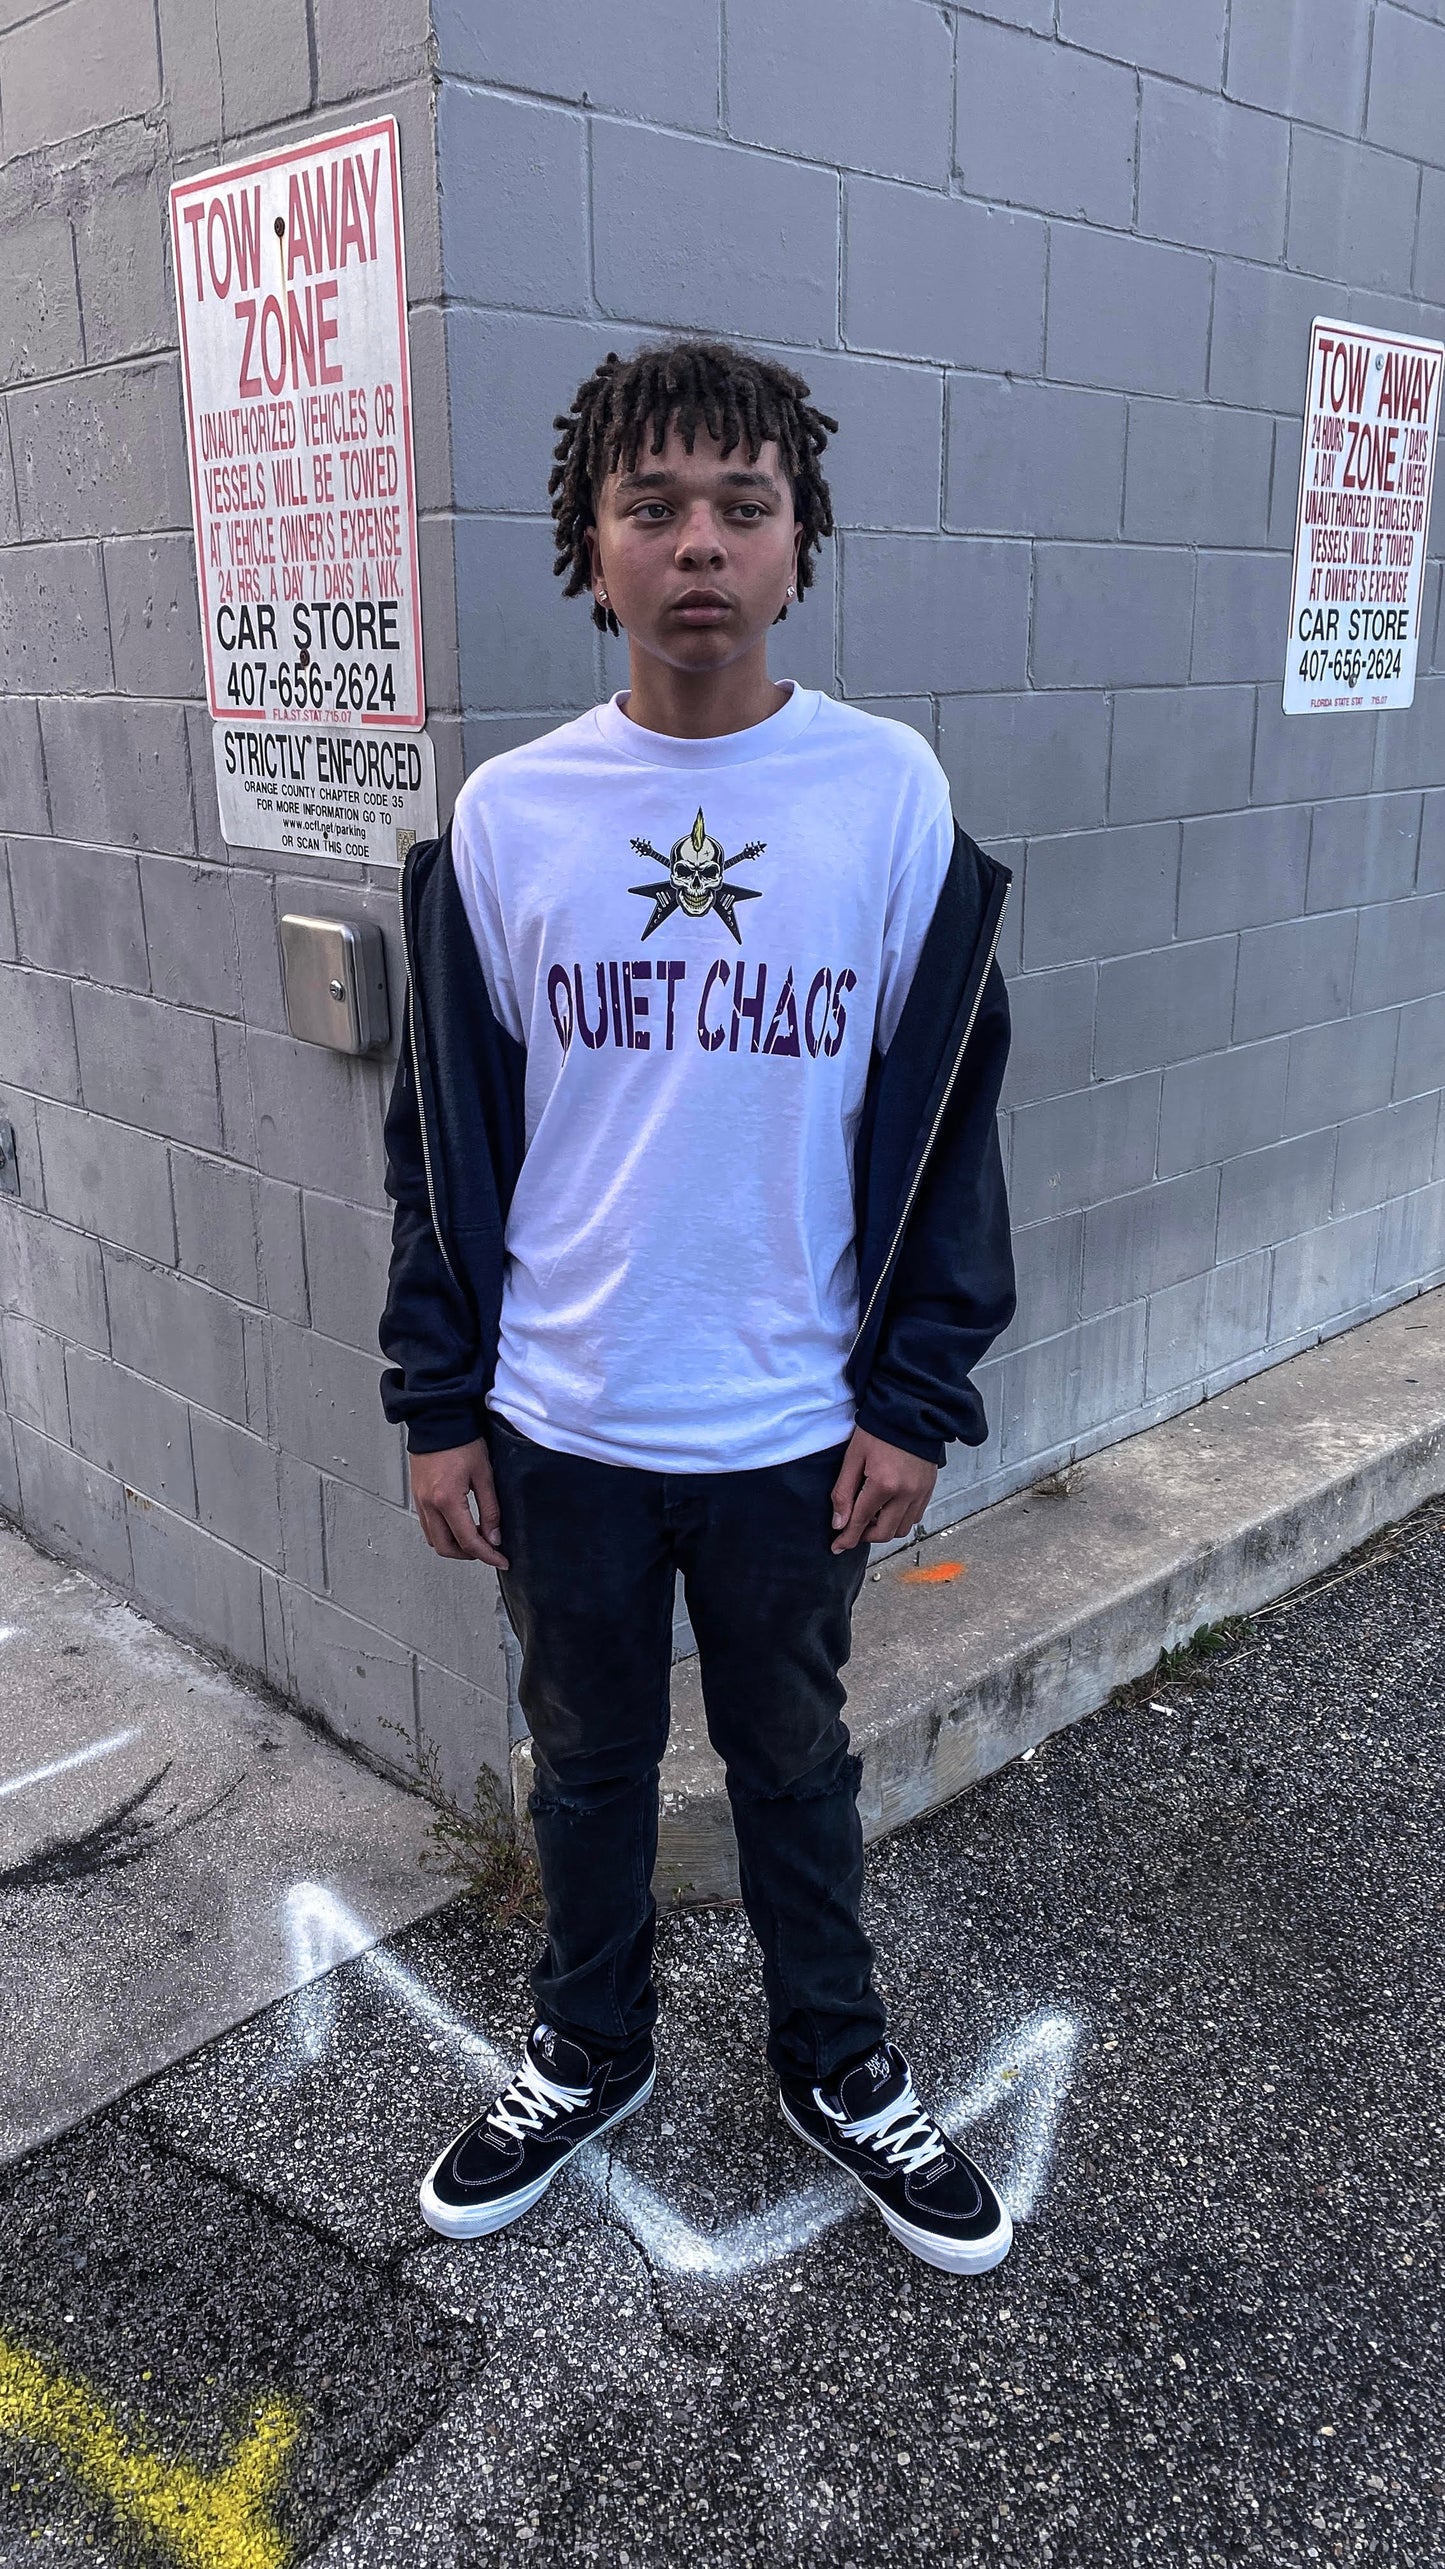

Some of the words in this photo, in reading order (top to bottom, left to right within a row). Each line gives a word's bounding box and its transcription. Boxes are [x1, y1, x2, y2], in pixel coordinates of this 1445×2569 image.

[183, 185, 261, 302] TOW
[287, 148, 381, 281] AWAY
[234, 279, 343, 399] ZONE
[1319, 338, 1371, 414] TOW
[1377, 352, 1437, 424] AWAY
[200, 400, 296, 462] UNAUTHORIZED
[301, 387, 367, 447] VEHICLES
[375, 383, 396, 438] OR
[1312, 414, 1321, 449] 24
[1321, 415, 1345, 452] HOURS
[1343, 421, 1399, 492] ZONE
[1403, 427, 1408, 460] 7
[1408, 428, 1428, 463] DAYS
[204, 461, 266, 514] VESSELS
[272, 457, 308, 507] WILL
[313, 453, 334, 503] BE
[340, 446, 398, 501] TOWED
[1313, 451, 1320, 486] A
[1321, 453, 1336, 488] DAY
[1397, 462, 1403, 494] A
[1406, 464, 1427, 497] WEEK
[1305, 490, 1371, 528] UNAUTHORIZED
[1374, 496, 1411, 531] VEHICLES
[1412, 500, 1423, 532] OR
[210, 522, 222, 567] AT
[226, 517, 276, 566] VEHICLE
[280, 511, 335, 564] OWNER'S
[340, 505, 402, 559] EXPENSE
[1311, 528, 1349, 564] VESSELS
[1351, 531, 1371, 564] WILL
[1372, 533, 1384, 565] BE
[1385, 534, 1414, 566] TOWED
[218, 570, 233, 604] 24
[237, 567, 264, 603] HRS.
[270, 567, 278, 601] A
[282, 566, 304, 601] DAY
[310, 565, 317, 600] 7
[323, 563, 354, 600] DAYS
[362, 562, 370, 598] A
[376, 561, 404, 598] WK.
[1309, 568, 1323, 601] AT
[1325, 569, 1367, 602] OWNER'S
[1368, 570, 1408, 603] EXPENSE
[217, 604, 278, 651] CAR
[293, 601, 400, 651] STORE
[1298, 608, 1340, 641] CAR
[1348, 608, 1409, 641] STORE
[1299, 648, 1401, 682] 407-656-2624
[227, 661, 396, 711] 407-656-2624
[1311, 698, 1332, 708] FLORIDA
[1334, 697, 1350, 707] STATE
[224, 731, 309, 780] STRICTLY
[317, 739, 422, 791] ENFORCED
[244, 781, 278, 795] ORANGE
[281, 784, 315, 799] COUNTY
[319, 787, 360, 803] CHAPTER
[363, 792, 388, 807] CODE
[392, 796, 404, 808] 35
[257, 799, 273, 811] FOR
[276, 801, 300, 814] MORE
[303, 804, 359, 821] INFORMATION
[363, 811, 376, 823] GO
[380, 812, 392, 825] TO
[282, 835, 293, 847] OR
[297, 837, 320, 850] SCAN
[323, 840, 342, 853] THIS
[345, 843, 370, 857] CODE
[283, 818, 366, 840] www.ocfl.net/parking
[547, 960, 686, 1068] QUIET
[697, 959, 858, 1059] CHAOS
